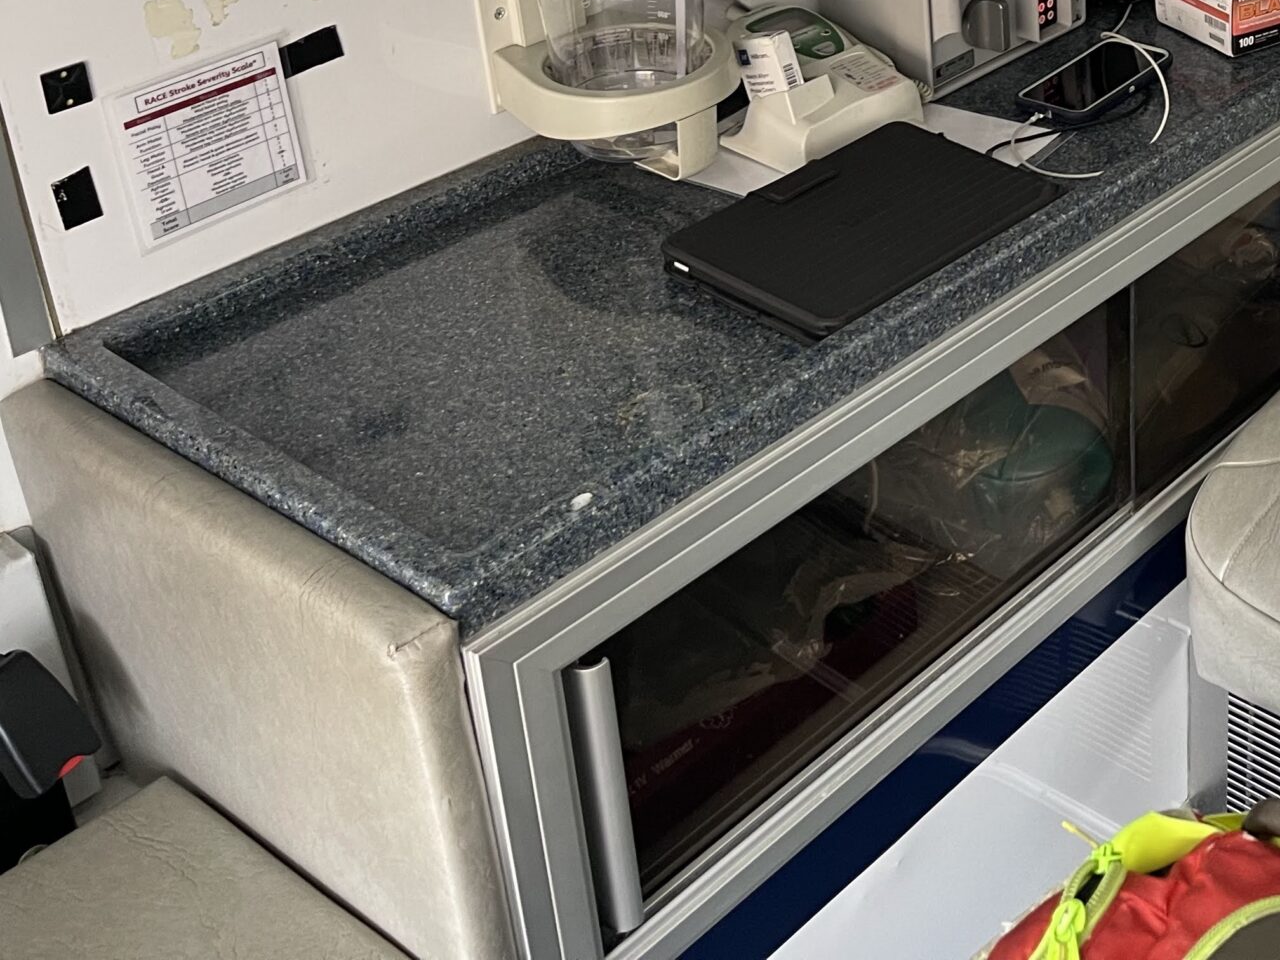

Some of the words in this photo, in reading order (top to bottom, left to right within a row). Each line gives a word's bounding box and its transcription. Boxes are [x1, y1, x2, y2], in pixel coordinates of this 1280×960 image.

[1239, 36, 1254, 48] 100
[144, 90, 168, 106] RACE
[169, 80, 196, 97] Stroke
[197, 69, 231, 88] Severity
